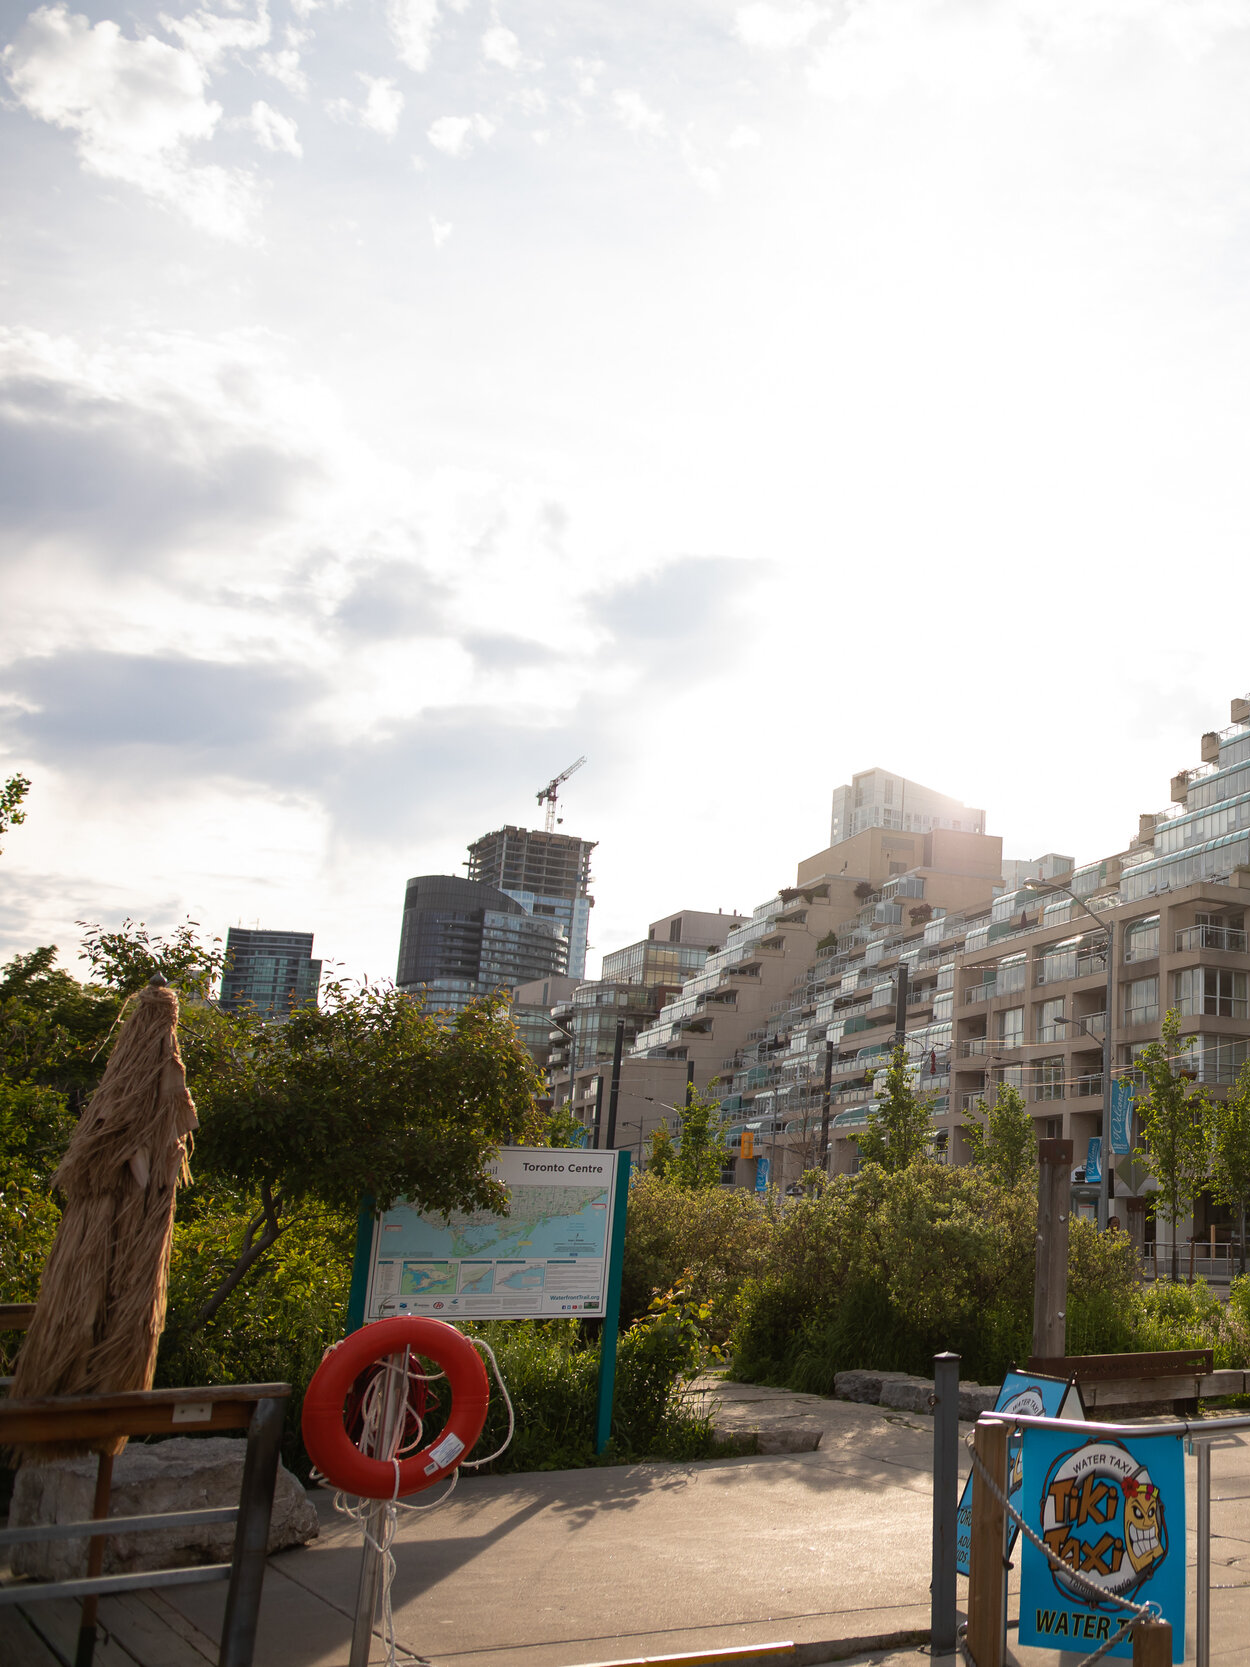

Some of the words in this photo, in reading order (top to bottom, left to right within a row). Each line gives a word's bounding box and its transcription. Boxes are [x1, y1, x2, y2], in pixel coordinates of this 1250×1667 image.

[484, 1166, 498, 1175] rail
[523, 1162, 565, 1173] Toronto
[568, 1164, 603, 1174] Centre
[549, 1294, 600, 1302] WaterfrontTrail.org
[1072, 1454, 1107, 1475] WATER
[1109, 1455, 1132, 1475] TAXI
[1102, 1578, 1132, 1595] Ontario
[1035, 1609, 1111, 1641] WATER
